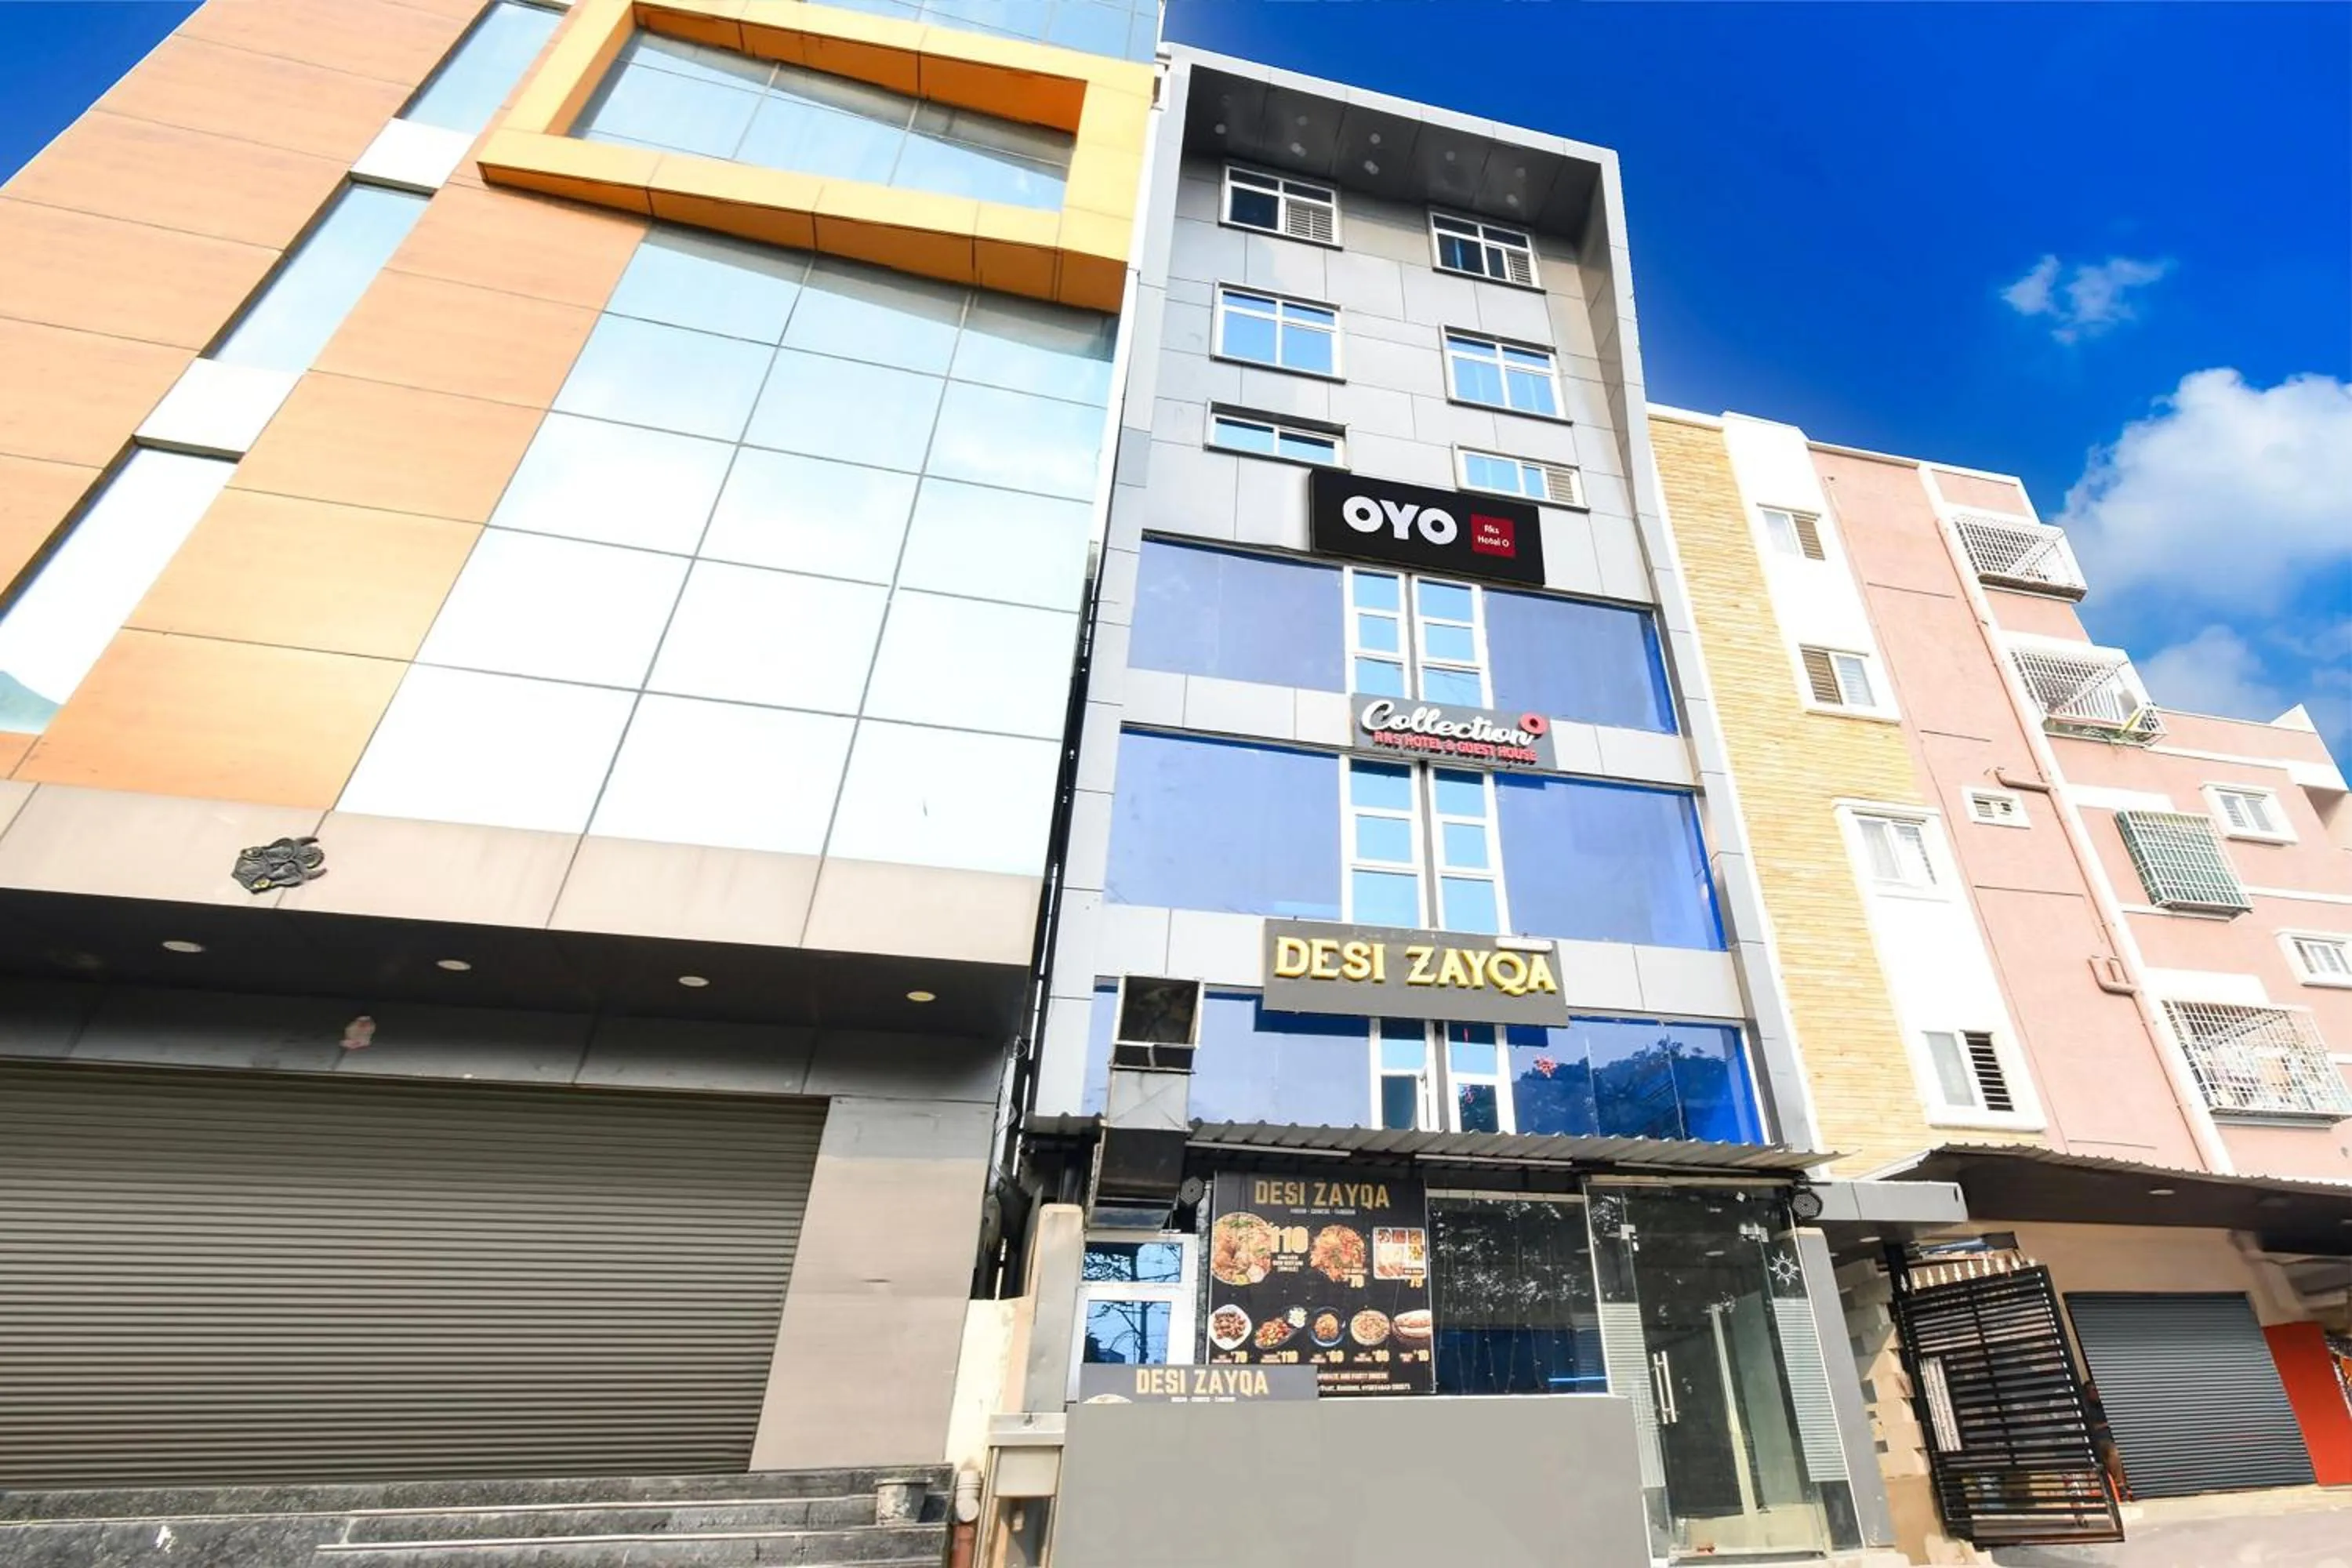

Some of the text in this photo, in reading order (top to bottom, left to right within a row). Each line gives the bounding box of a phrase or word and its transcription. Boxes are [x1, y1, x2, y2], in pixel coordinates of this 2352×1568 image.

[1343, 495, 1457, 545] OYO
[1361, 699, 1534, 746] Collection
[1404, 733, 1443, 750] HOTEL
[1457, 741, 1495, 757] GUEST
[1274, 936, 1558, 996] DESI ZAYQA
[1255, 1180, 1390, 1210] DESI ZAYQA
[1137, 1368, 1269, 1396] DESI ZAYQA
